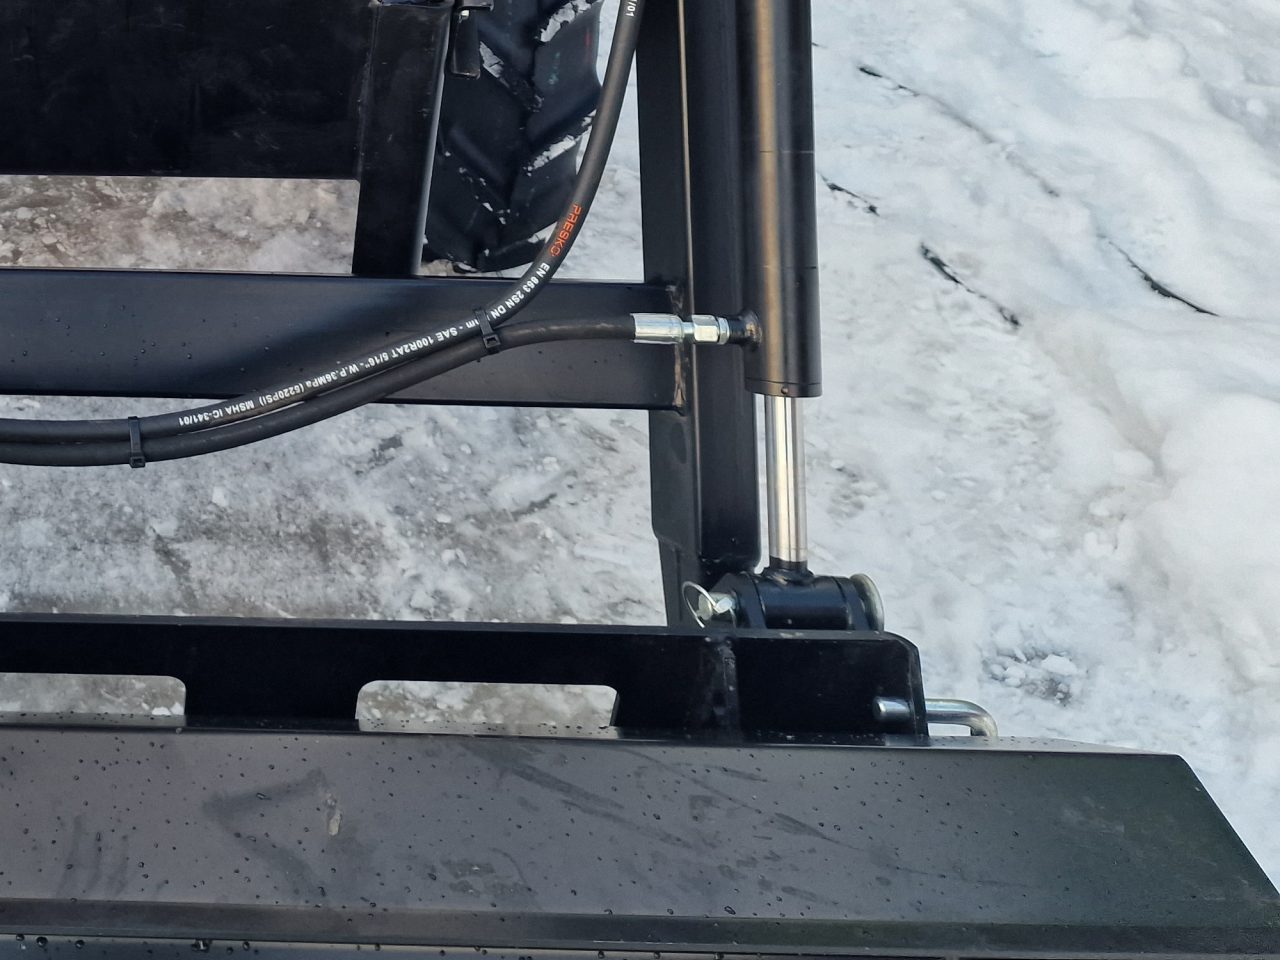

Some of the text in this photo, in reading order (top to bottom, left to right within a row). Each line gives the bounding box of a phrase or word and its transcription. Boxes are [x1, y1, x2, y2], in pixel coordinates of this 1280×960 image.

[535, 262, 551, 278] EN
[504, 290, 525, 309] 2SN
[490, 304, 507, 320] DN
[436, 326, 458, 342] SAE
[391, 338, 434, 358] 100R2AT
[305, 364, 360, 389] W.P.36MPa
[260, 382, 305, 407] (5220PSI)
[225, 400, 255, 416] MSHA
[178, 410, 223, 426] IC-341/01
